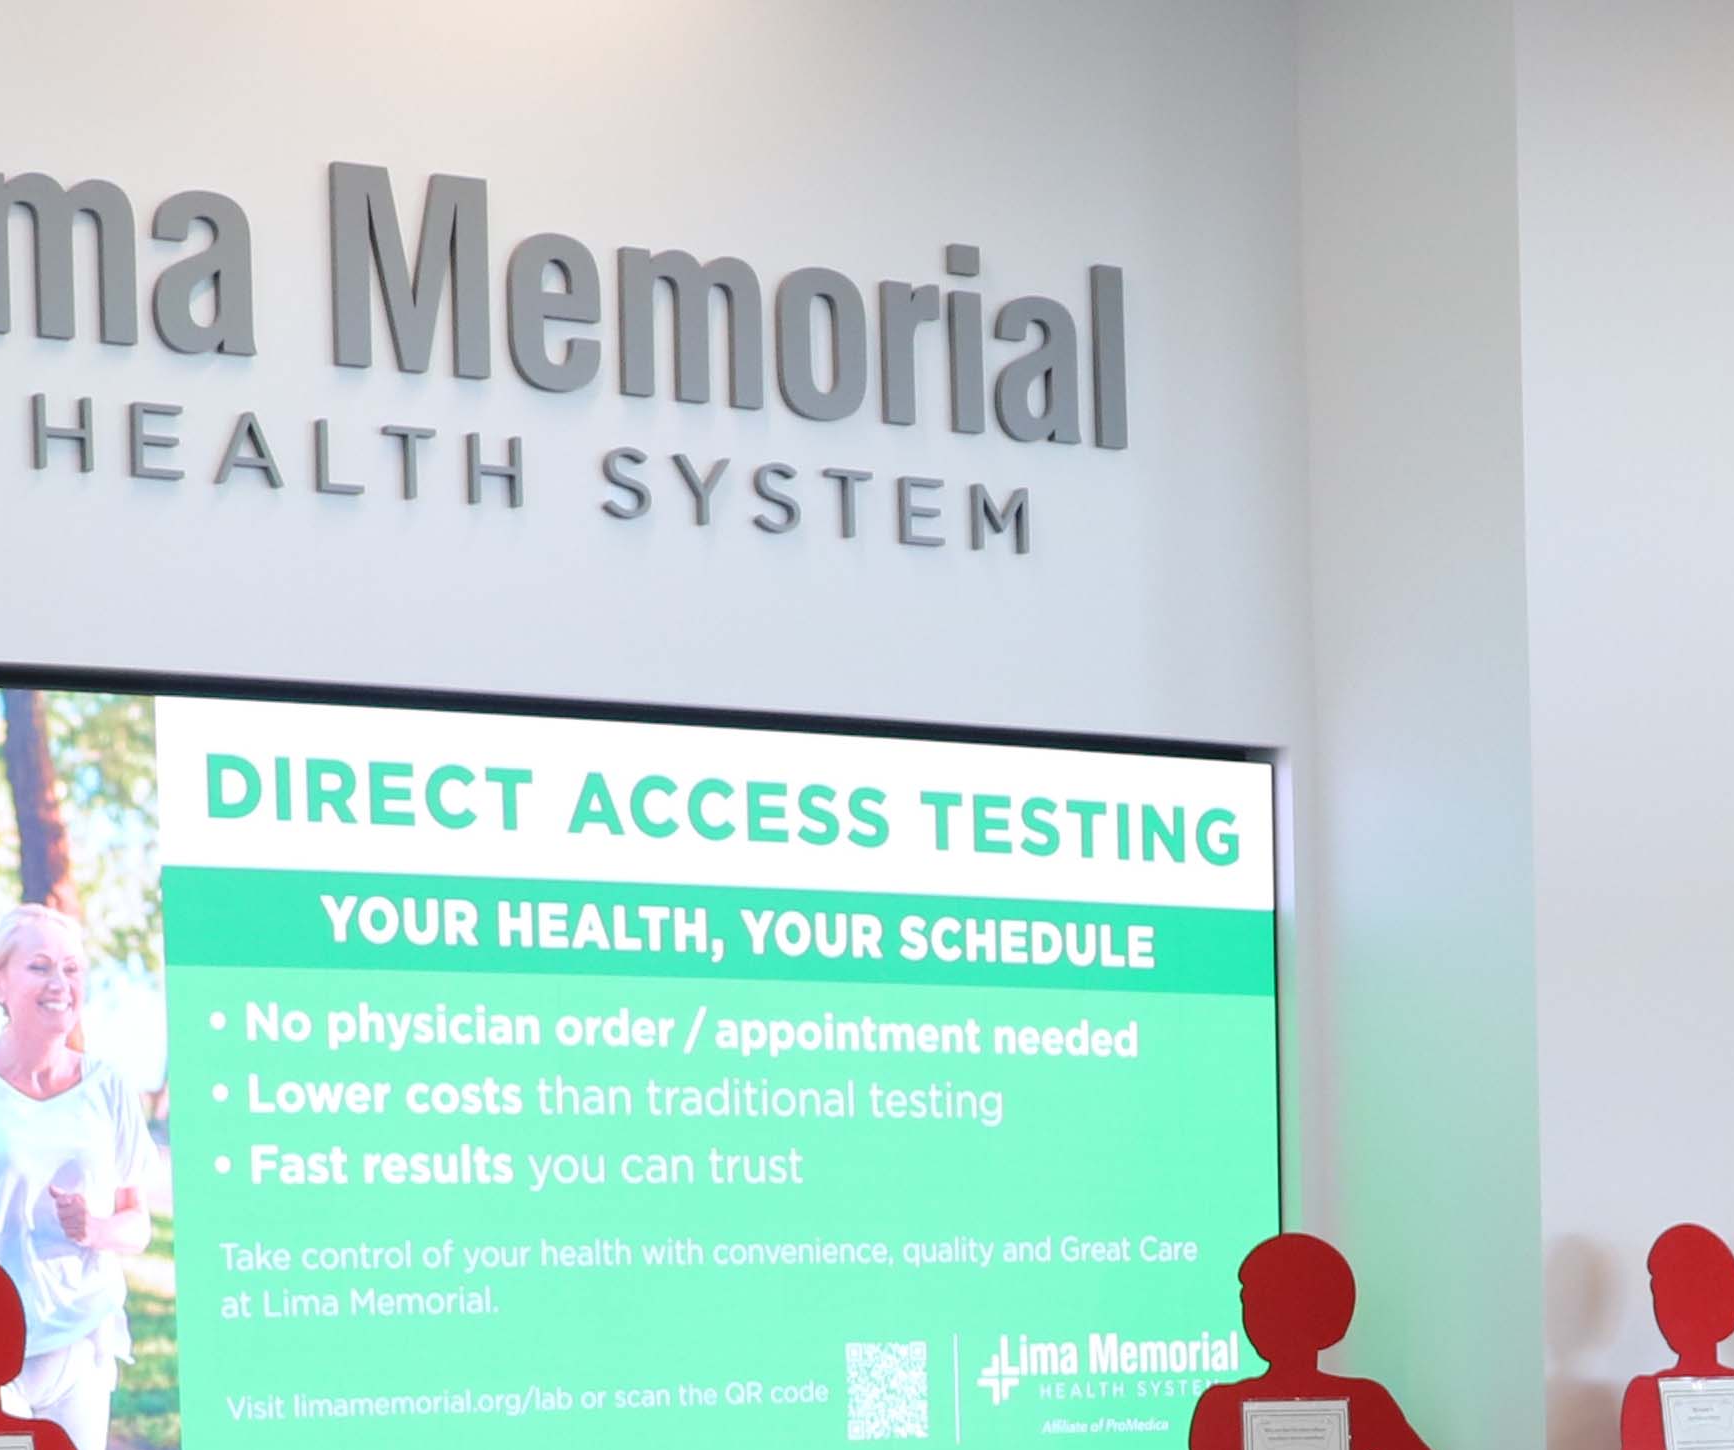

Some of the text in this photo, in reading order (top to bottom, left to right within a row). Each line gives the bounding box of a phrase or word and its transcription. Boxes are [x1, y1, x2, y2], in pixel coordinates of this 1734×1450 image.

[327, 160, 1130, 451] Memorial
[30, 393, 1031, 555] HEALTH SYSTEM
[206, 753, 1240, 867] DIRECT ACCESS TESTING
[320, 895, 1156, 969] YOUR HEALTH, YOUR SCHEDULE
[245, 1001, 1139, 1057] No physician order / appointment needed
[248, 1073, 1004, 1127] Lower costs than traditional testing
[250, 1143, 804, 1192] Fast results you can trust
[218, 1235, 1199, 1274] Take control of your health with convenience, quality and Great Care
[221, 1285, 499, 1319] at Lima Memorial.
[1000, 1332, 1239, 1376] Lima Memorial
[226, 1380, 830, 1421] Visit limamemorial.org/lab or scan the QR code
[1040, 1381, 1124, 1399] HEALTH
[1043, 1418, 1169, 1434] Affiliate of ProMedica
